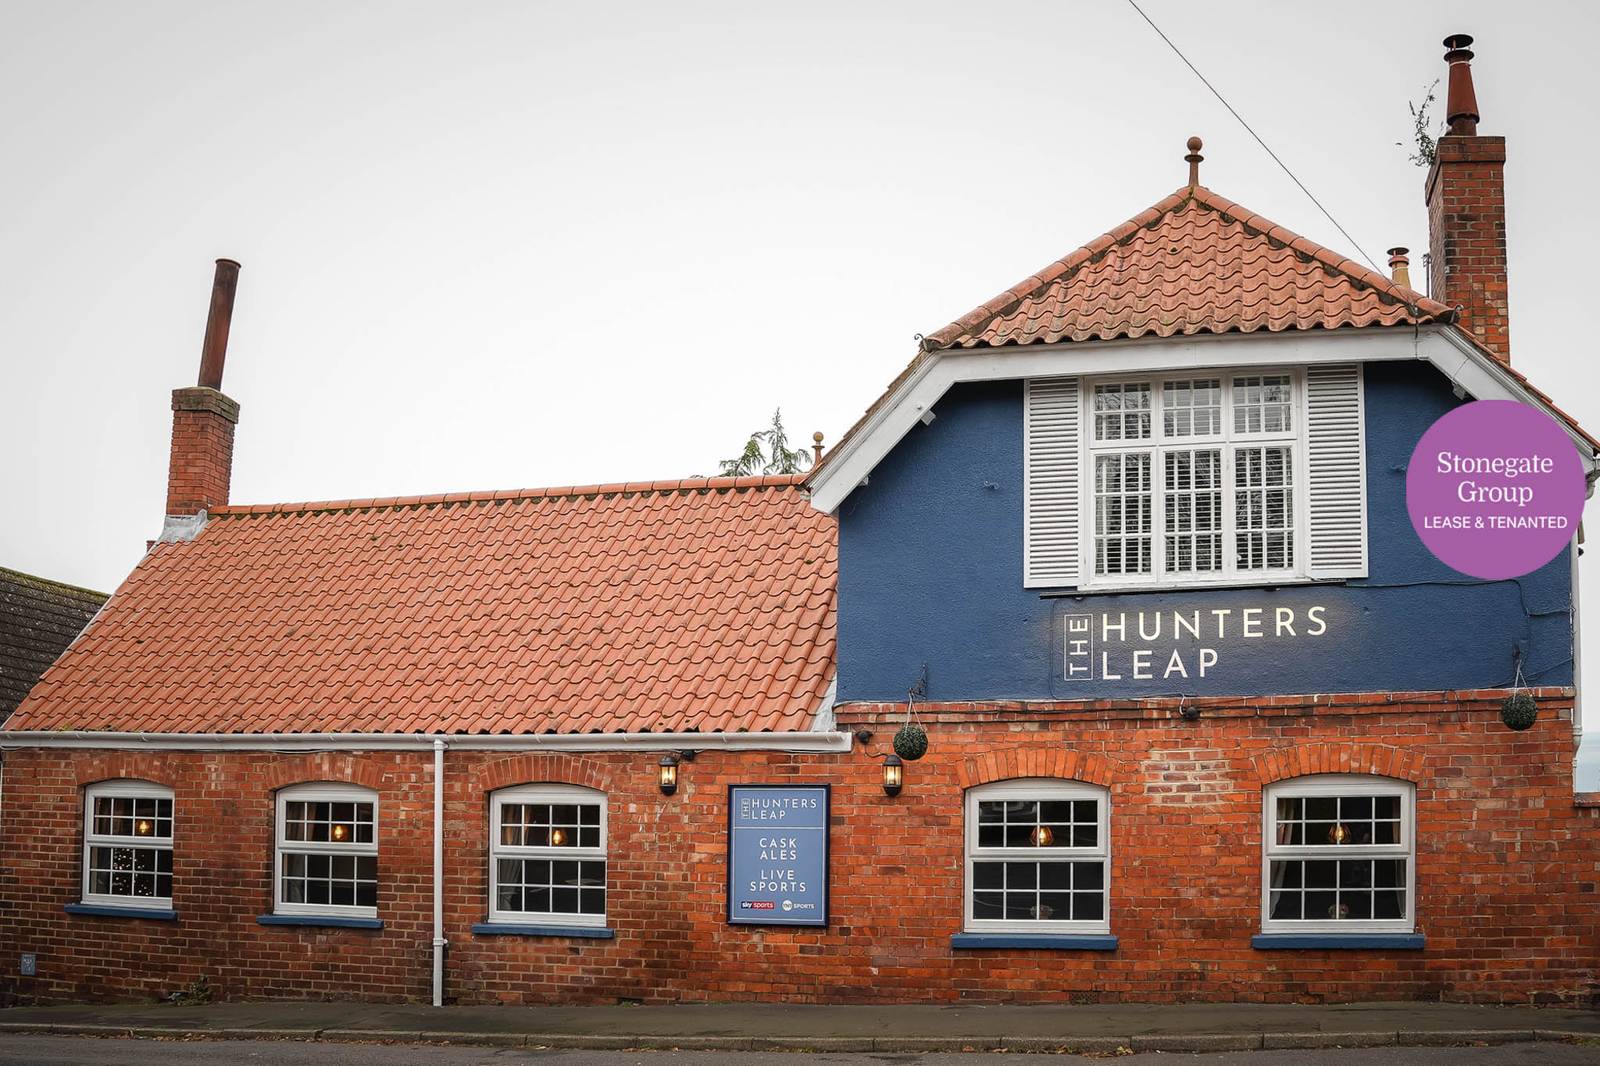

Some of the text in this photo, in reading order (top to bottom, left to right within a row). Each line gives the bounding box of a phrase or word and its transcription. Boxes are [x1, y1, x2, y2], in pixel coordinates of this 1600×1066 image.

[1102, 606, 1328, 642] HUNTERS
[1069, 617, 1089, 675] THE
[1102, 648, 1219, 680] LEAP
[752, 798, 817, 808] HUNTERS
[752, 810, 786, 820] LEAP
[759, 838, 797, 848] CASK
[759, 850, 797, 860] ALES
[761, 870, 795, 880] LIVE
[750, 881, 806, 892] SPORTS
